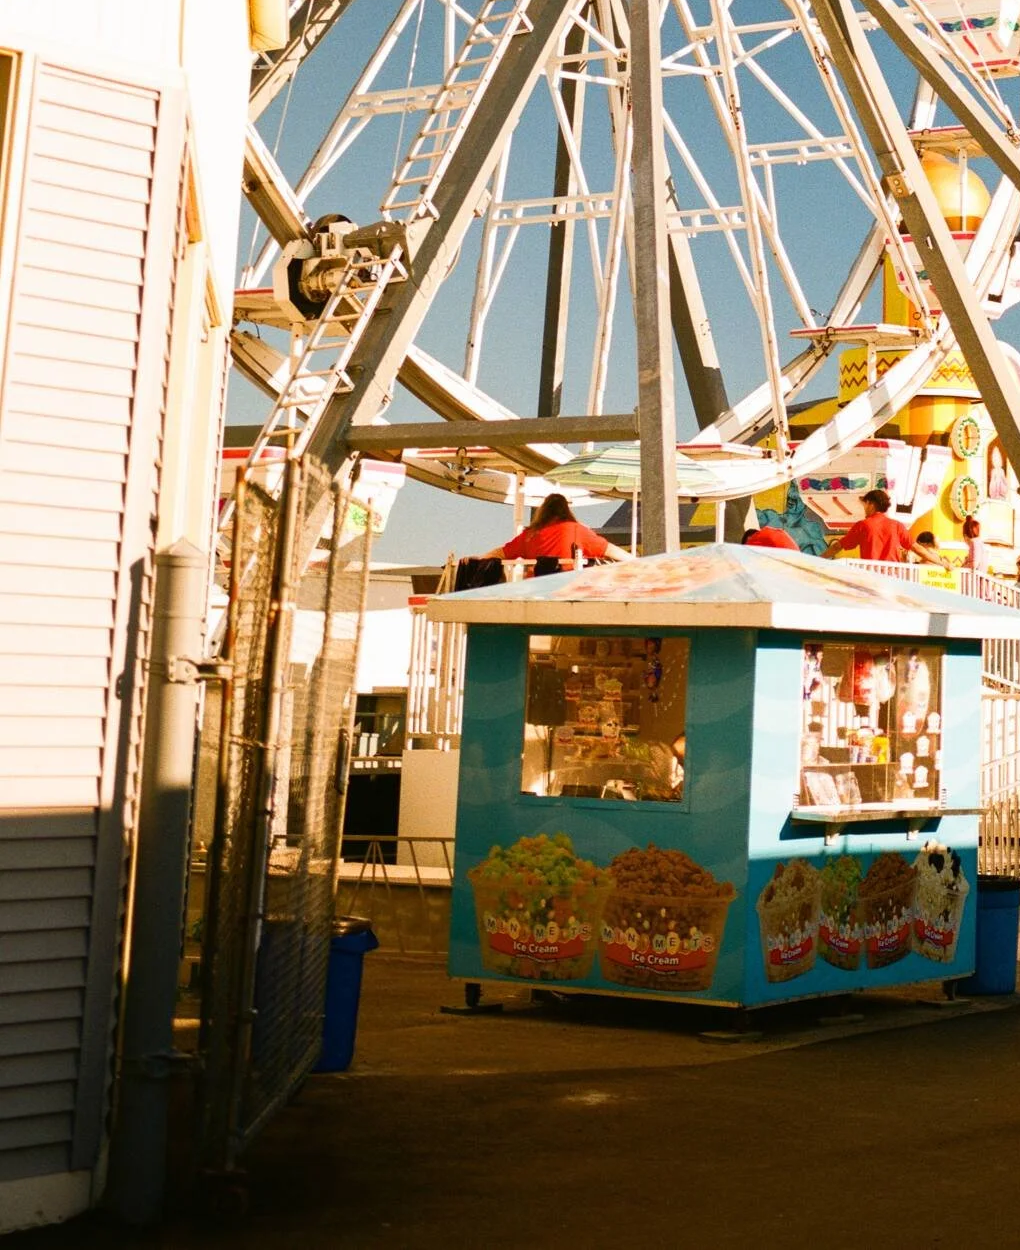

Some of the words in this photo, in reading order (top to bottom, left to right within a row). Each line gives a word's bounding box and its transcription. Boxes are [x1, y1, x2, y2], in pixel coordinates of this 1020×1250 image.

[513, 941, 527, 952] Ice
[529, 944, 559, 954] Cream
[631, 952, 645, 963] Ice
[647, 955, 680, 966] Cream
